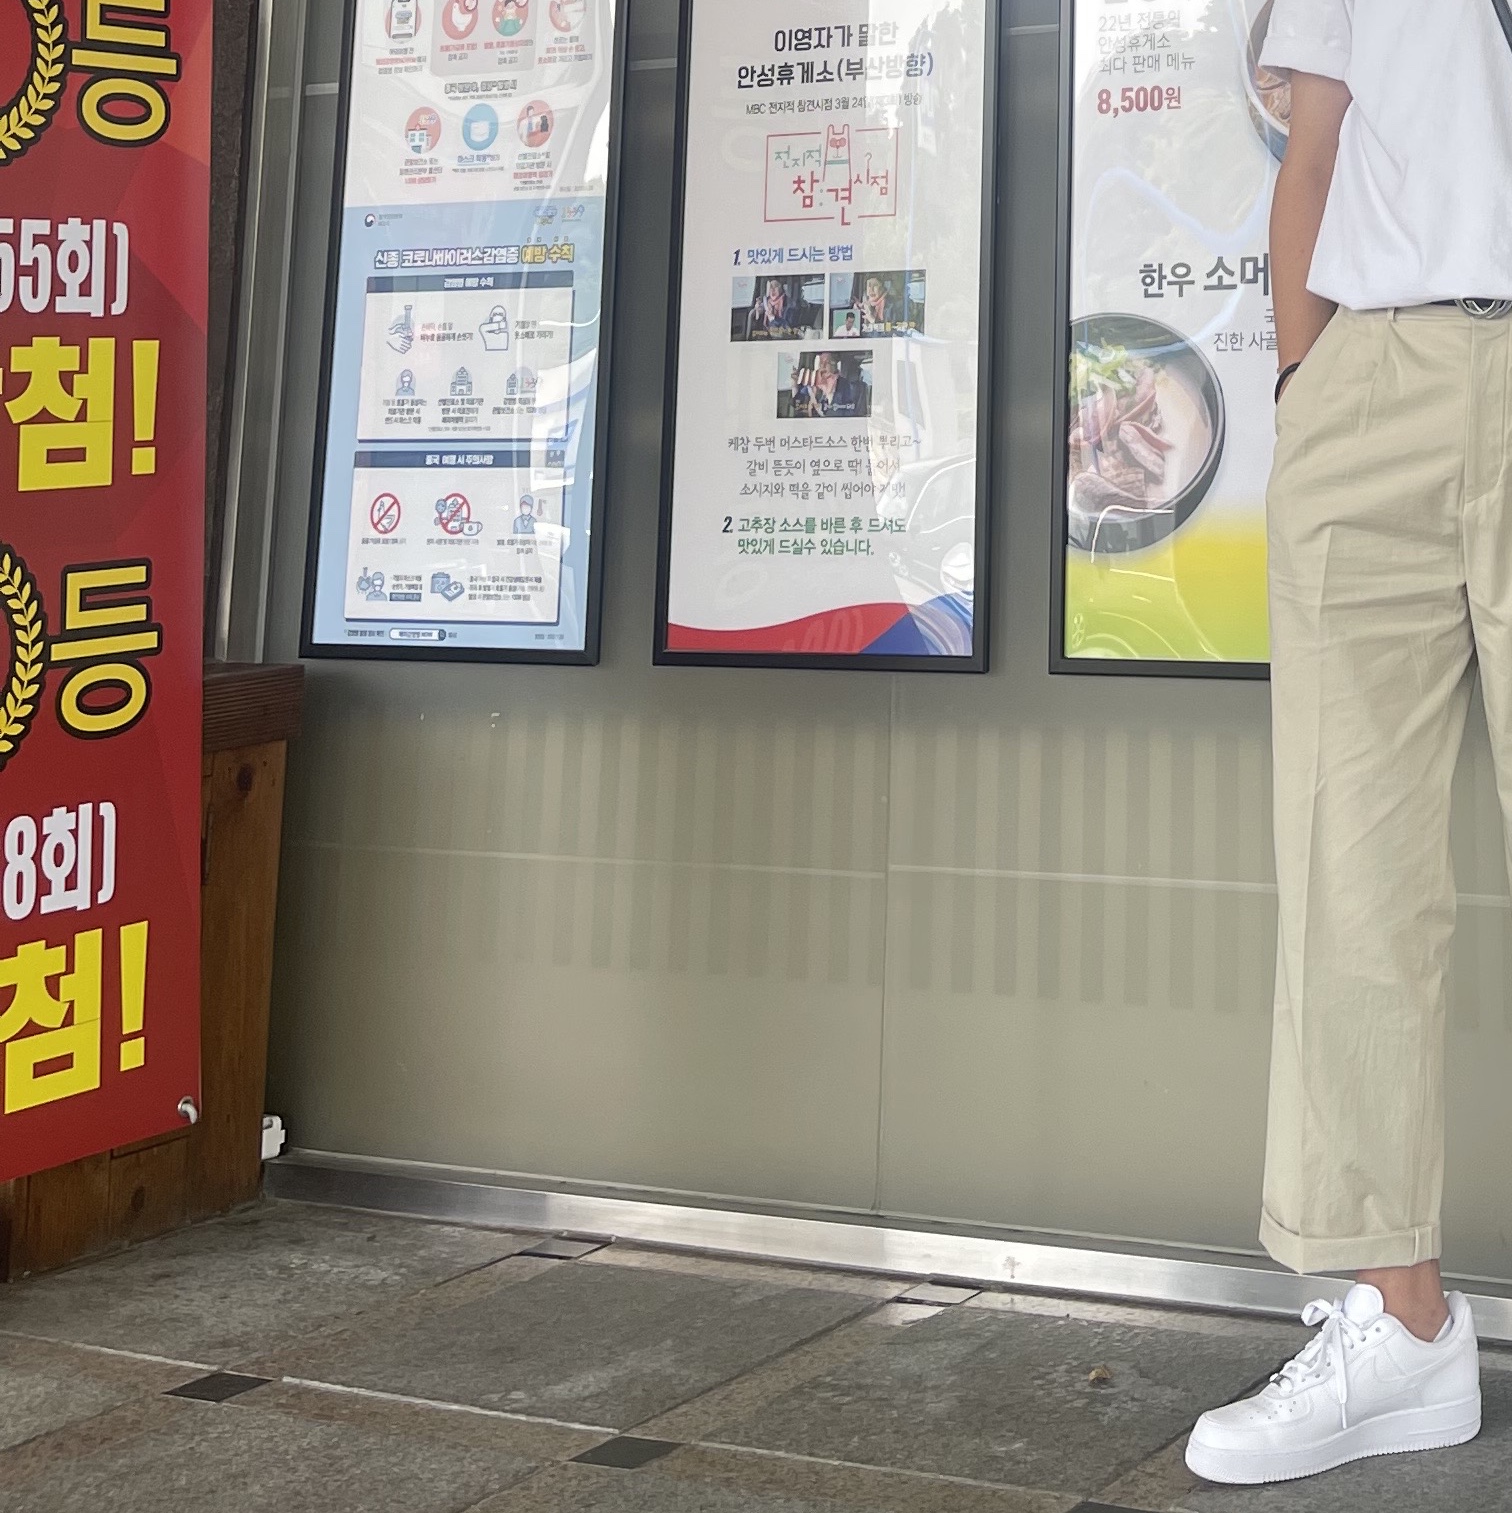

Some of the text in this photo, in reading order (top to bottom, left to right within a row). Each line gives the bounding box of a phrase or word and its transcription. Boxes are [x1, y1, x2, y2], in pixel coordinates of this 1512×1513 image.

[1098, 14, 1131, 32] 22년
[774, 21, 900, 52] 이영자가 말한
[1099, 33, 1172, 54] 안성휴게소
[737, 52, 935, 89] 안성휴게소(부산방향)
[1132, 52, 1196, 74] 판매 메뉴
[745, 103, 767, 115] MBC
[768, 100, 795, 115] 전지적
[796, 98, 834, 113] 참견시점
[834, 96, 850, 111] 3월
[1097, 85, 1182, 118] 8,500원
[774, 144, 823, 169] 전지적
[853, 166, 889, 196] 시점
[374, 250, 400, 269] 신종
[401, 245, 520, 269] 코로나바이러스감염증
[548, 243, 575, 263] 수칙
[747, 247, 785, 265] 맛있게
[787, 246, 825, 263] 드시는
[828, 245, 853, 262] 방법
[1139, 262, 1195, 298] 한우
[1213, 331, 1244, 352] 진한
[0, 336, 160, 492] 첨!
[727, 436, 751, 453] 케찹
[752, 435, 776, 451] 두번
[779, 435, 848, 449] 머스타드소스
[746, 459, 845, 477] 갈비 뜯듯이 옆으로
[739, 482, 838, 500] 소시지와 떡을 같이
[722, 516, 907, 534] 2. 고추장 소스를 바른 후 드셔도
[737, 537, 875, 556] 맛있게 드실수 있습니다.
[49, 565, 160, 733] 등
